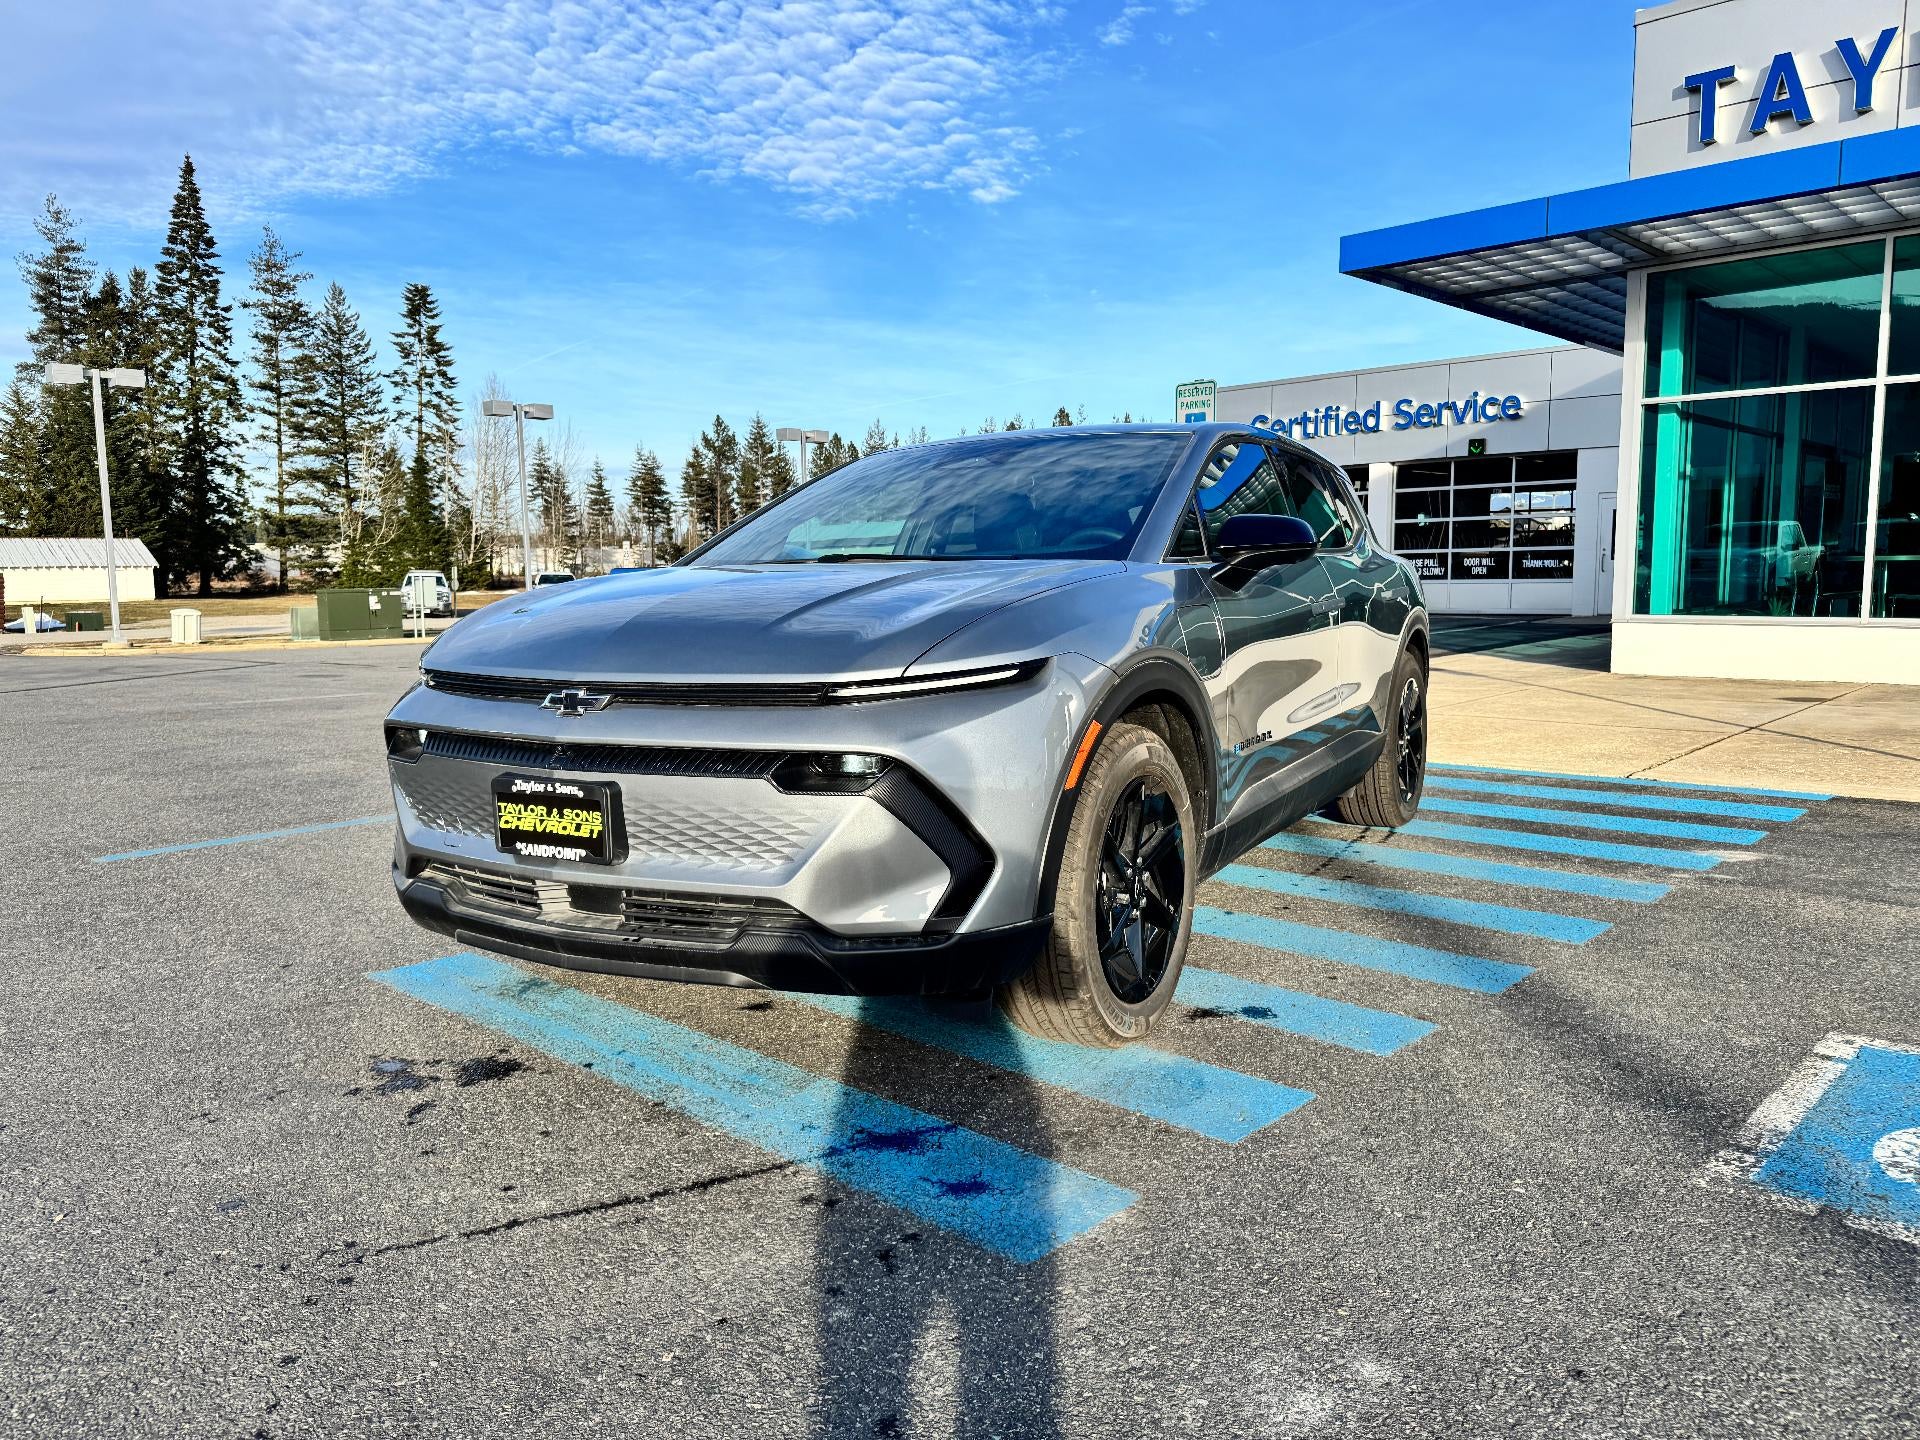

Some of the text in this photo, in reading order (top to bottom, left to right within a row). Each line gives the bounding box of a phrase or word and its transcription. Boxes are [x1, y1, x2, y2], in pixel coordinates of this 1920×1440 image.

[1683, 26, 1899, 144] TAY
[1178, 386, 1213, 398] RESERVED
[1180, 399, 1211, 410] PARKING
[1393, 390, 1522, 430] Service
[1424, 558, 1438, 567] PULL
[1463, 557, 1496, 566] DOOR WILL
[1522, 559, 1543, 568] THANK
[1422, 567, 1446, 576] SLOWLY
[1471, 566, 1487, 575] OPEN
[514, 780, 579, 795] Taylor & Sons
[497, 802, 602, 824] TAYLOR & SONS
[499, 815, 603, 839] CHEVROLET
